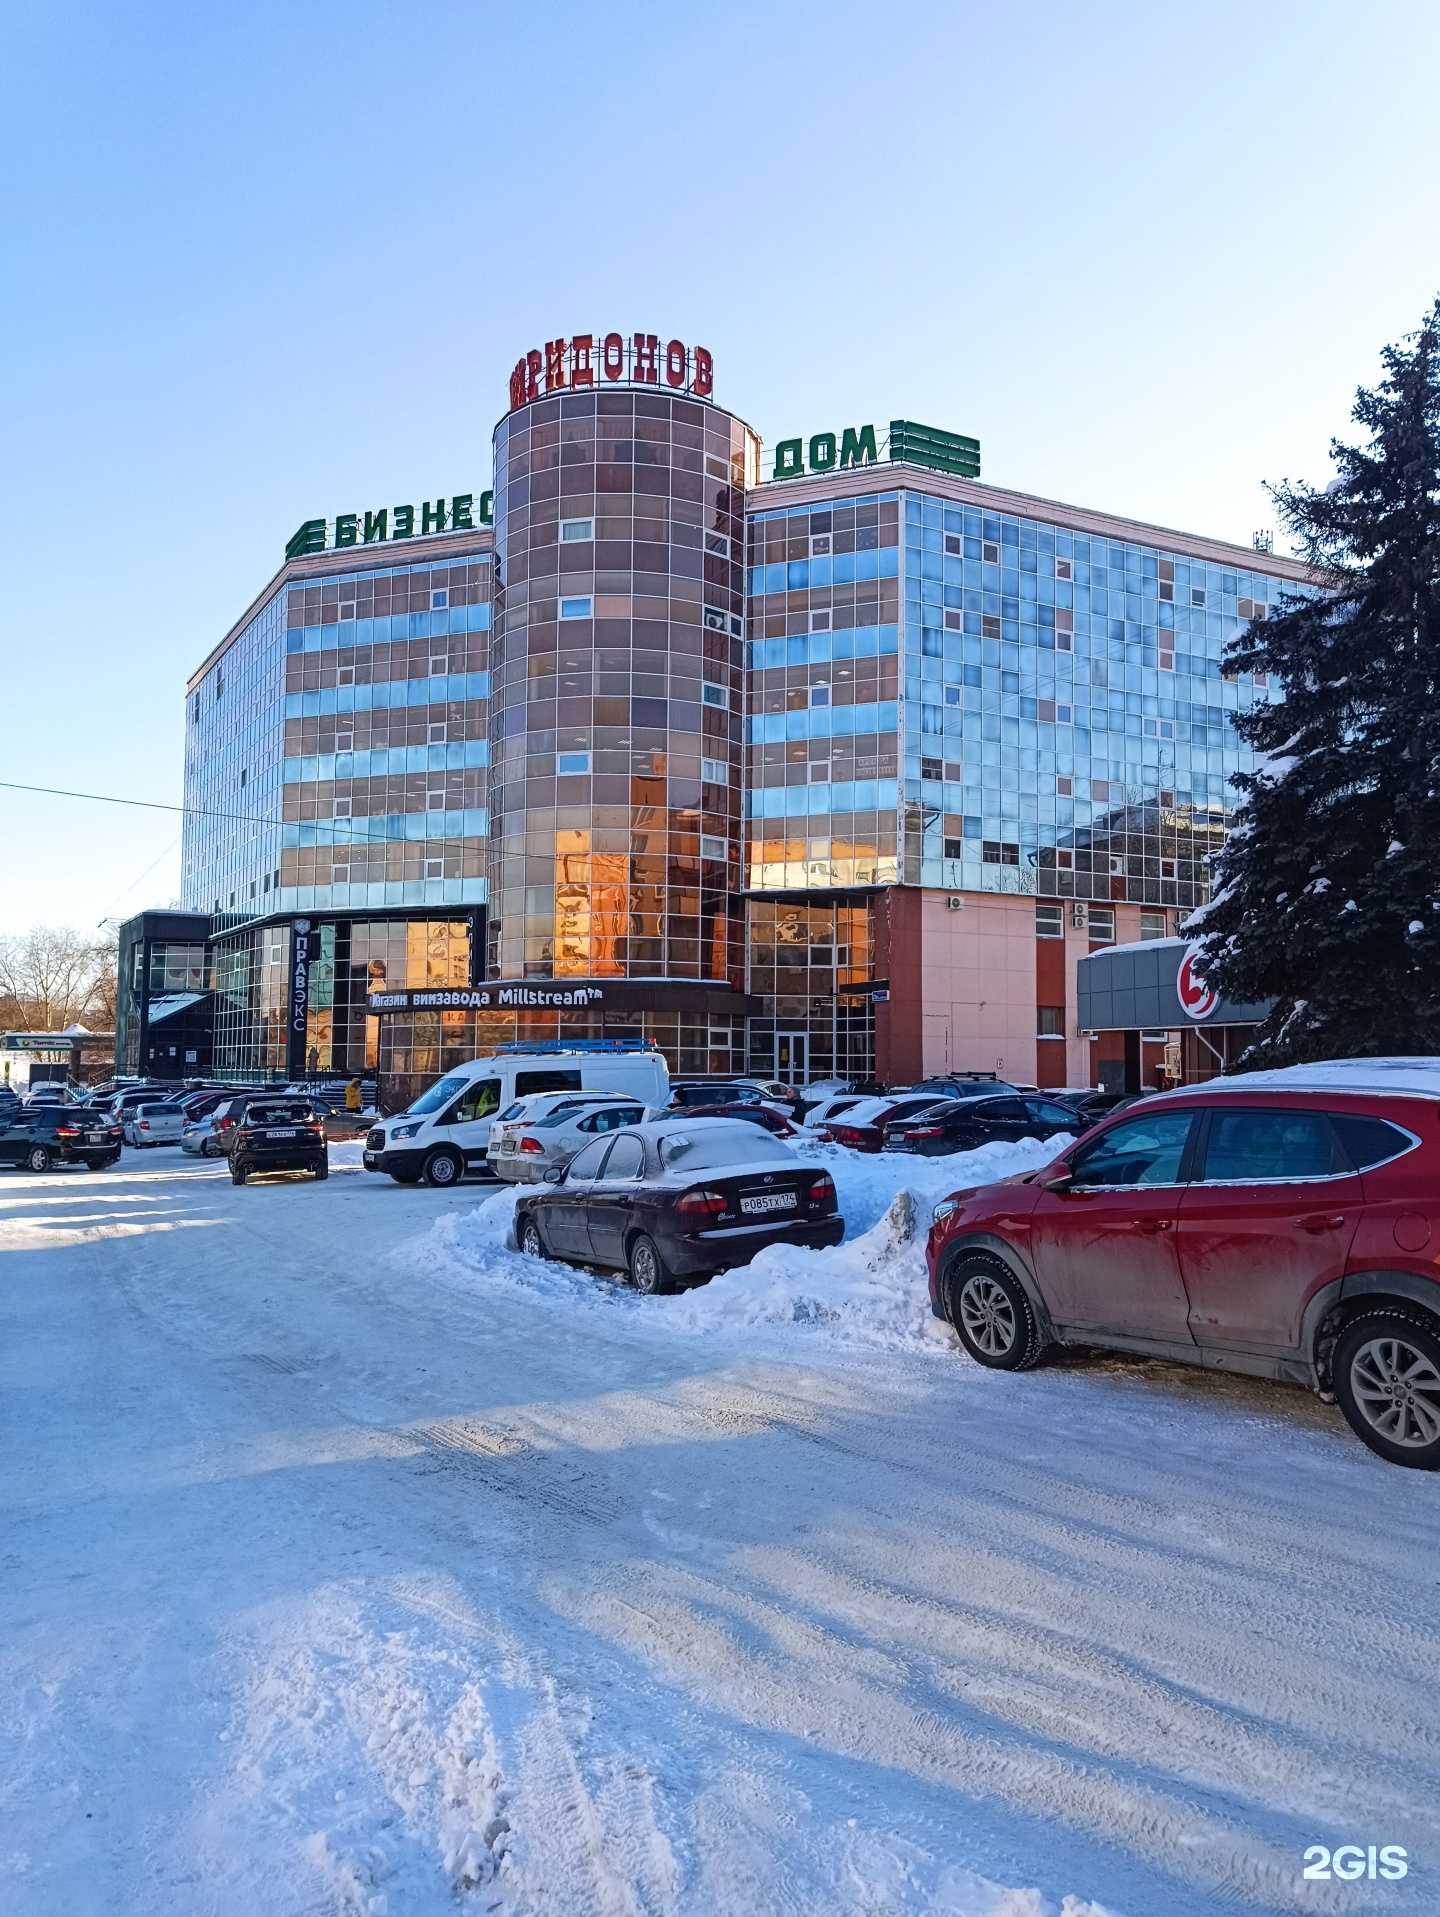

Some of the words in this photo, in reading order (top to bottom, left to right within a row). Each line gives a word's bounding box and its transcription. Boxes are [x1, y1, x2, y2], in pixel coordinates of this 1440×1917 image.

[773, 424, 877, 479] ДОМ
[293, 936, 308, 1031] ПРАВЭКС
[412, 991, 491, 1007] винзавода
